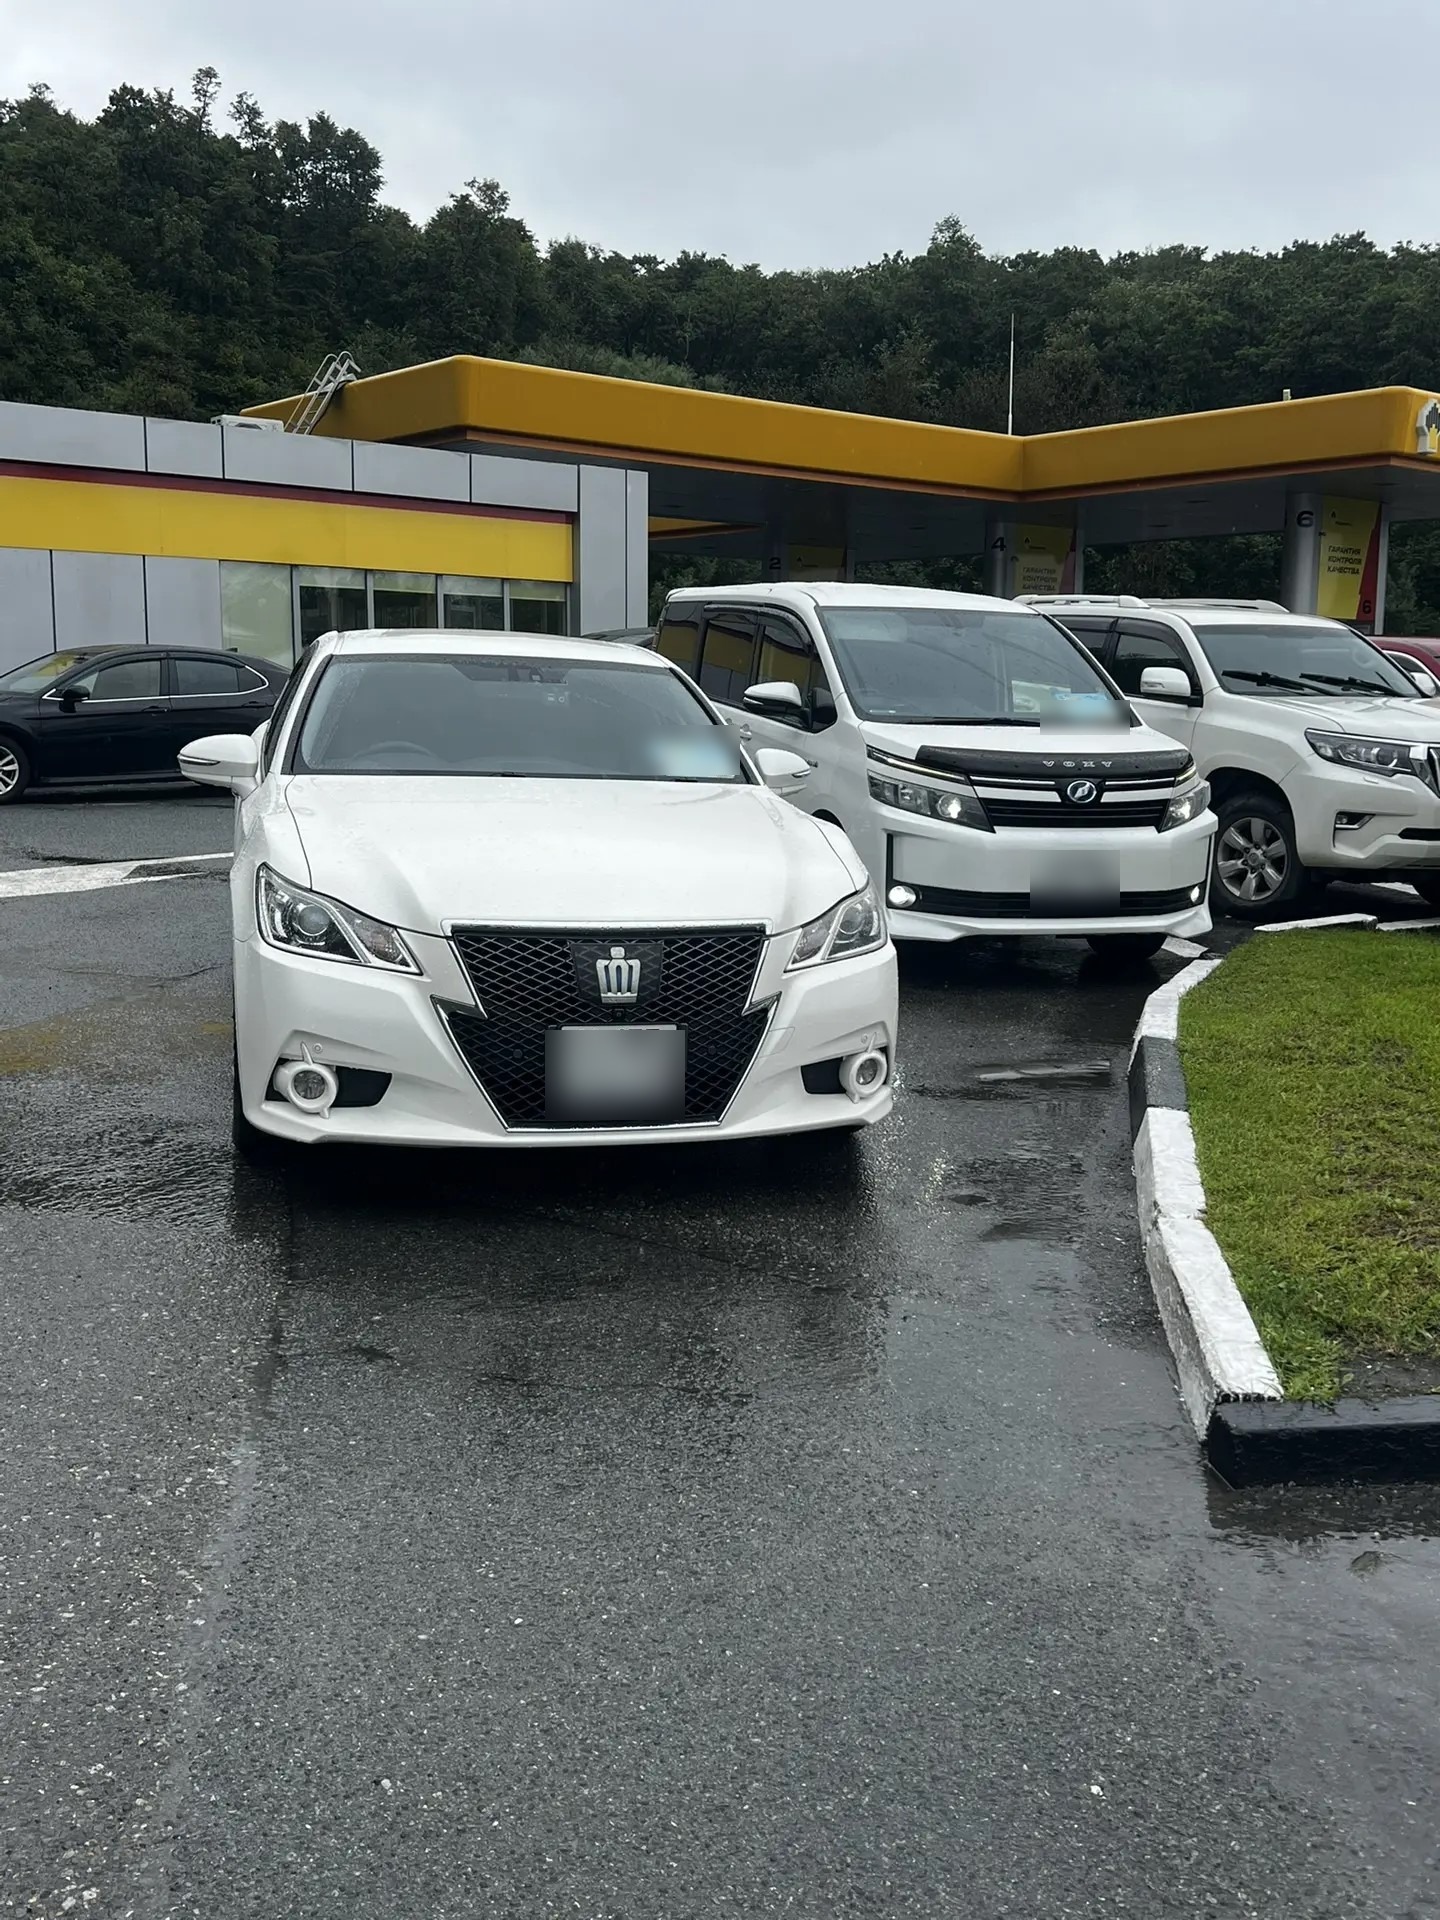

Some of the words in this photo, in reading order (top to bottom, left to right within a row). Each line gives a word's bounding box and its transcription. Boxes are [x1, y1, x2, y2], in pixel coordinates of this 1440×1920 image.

[1296, 510, 1314, 528] 6
[991, 536, 1007, 552] 4
[1328, 545, 1361, 555] ГАРАНТИЯ
[769, 557, 781, 570] 2
[1327, 555, 1362, 566] КОНТРОЛЯ
[1327, 565, 1360, 575] КАЧЕСТВА
[1362, 600, 1372, 614] 6
